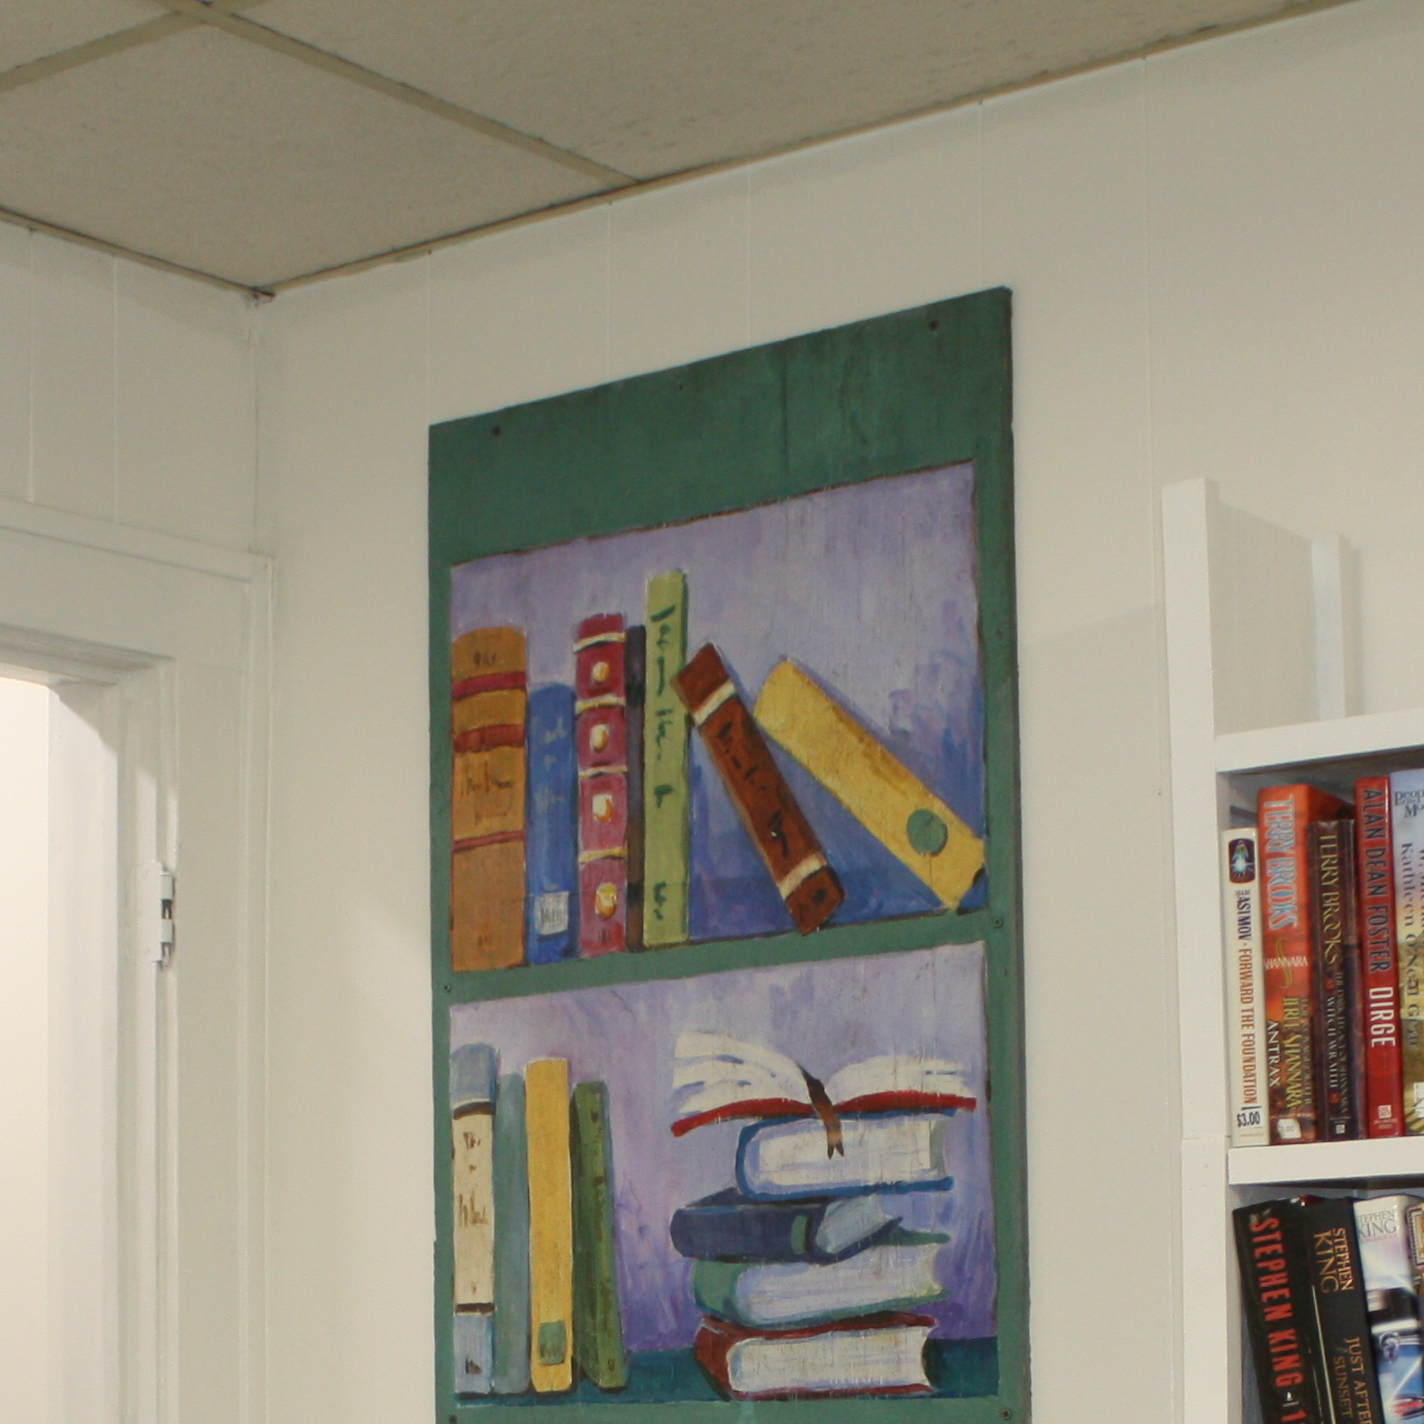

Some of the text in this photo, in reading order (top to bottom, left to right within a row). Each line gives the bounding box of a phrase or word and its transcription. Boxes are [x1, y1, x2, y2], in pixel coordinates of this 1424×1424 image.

[1363, 789, 1391, 972] ALAN DEAN FOSTER
[1238, 949, 1253, 1003] FORWARD
[1241, 1008, 1254, 1030] THE
[1369, 986, 1396, 1048] DIRGE
[1242, 1033, 1257, 1104] FOUNDATION
[1267, 1021, 1281, 1088] ANTRAX
[1313, 1231, 1340, 1294] KING
[1332, 1227, 1354, 1291] STEPHEN
[1250, 1217, 1304, 1388] STEPHEN KING
[1333, 1356, 1353, 1418] SUNSET
[1344, 1337, 1364, 1374] JUST
